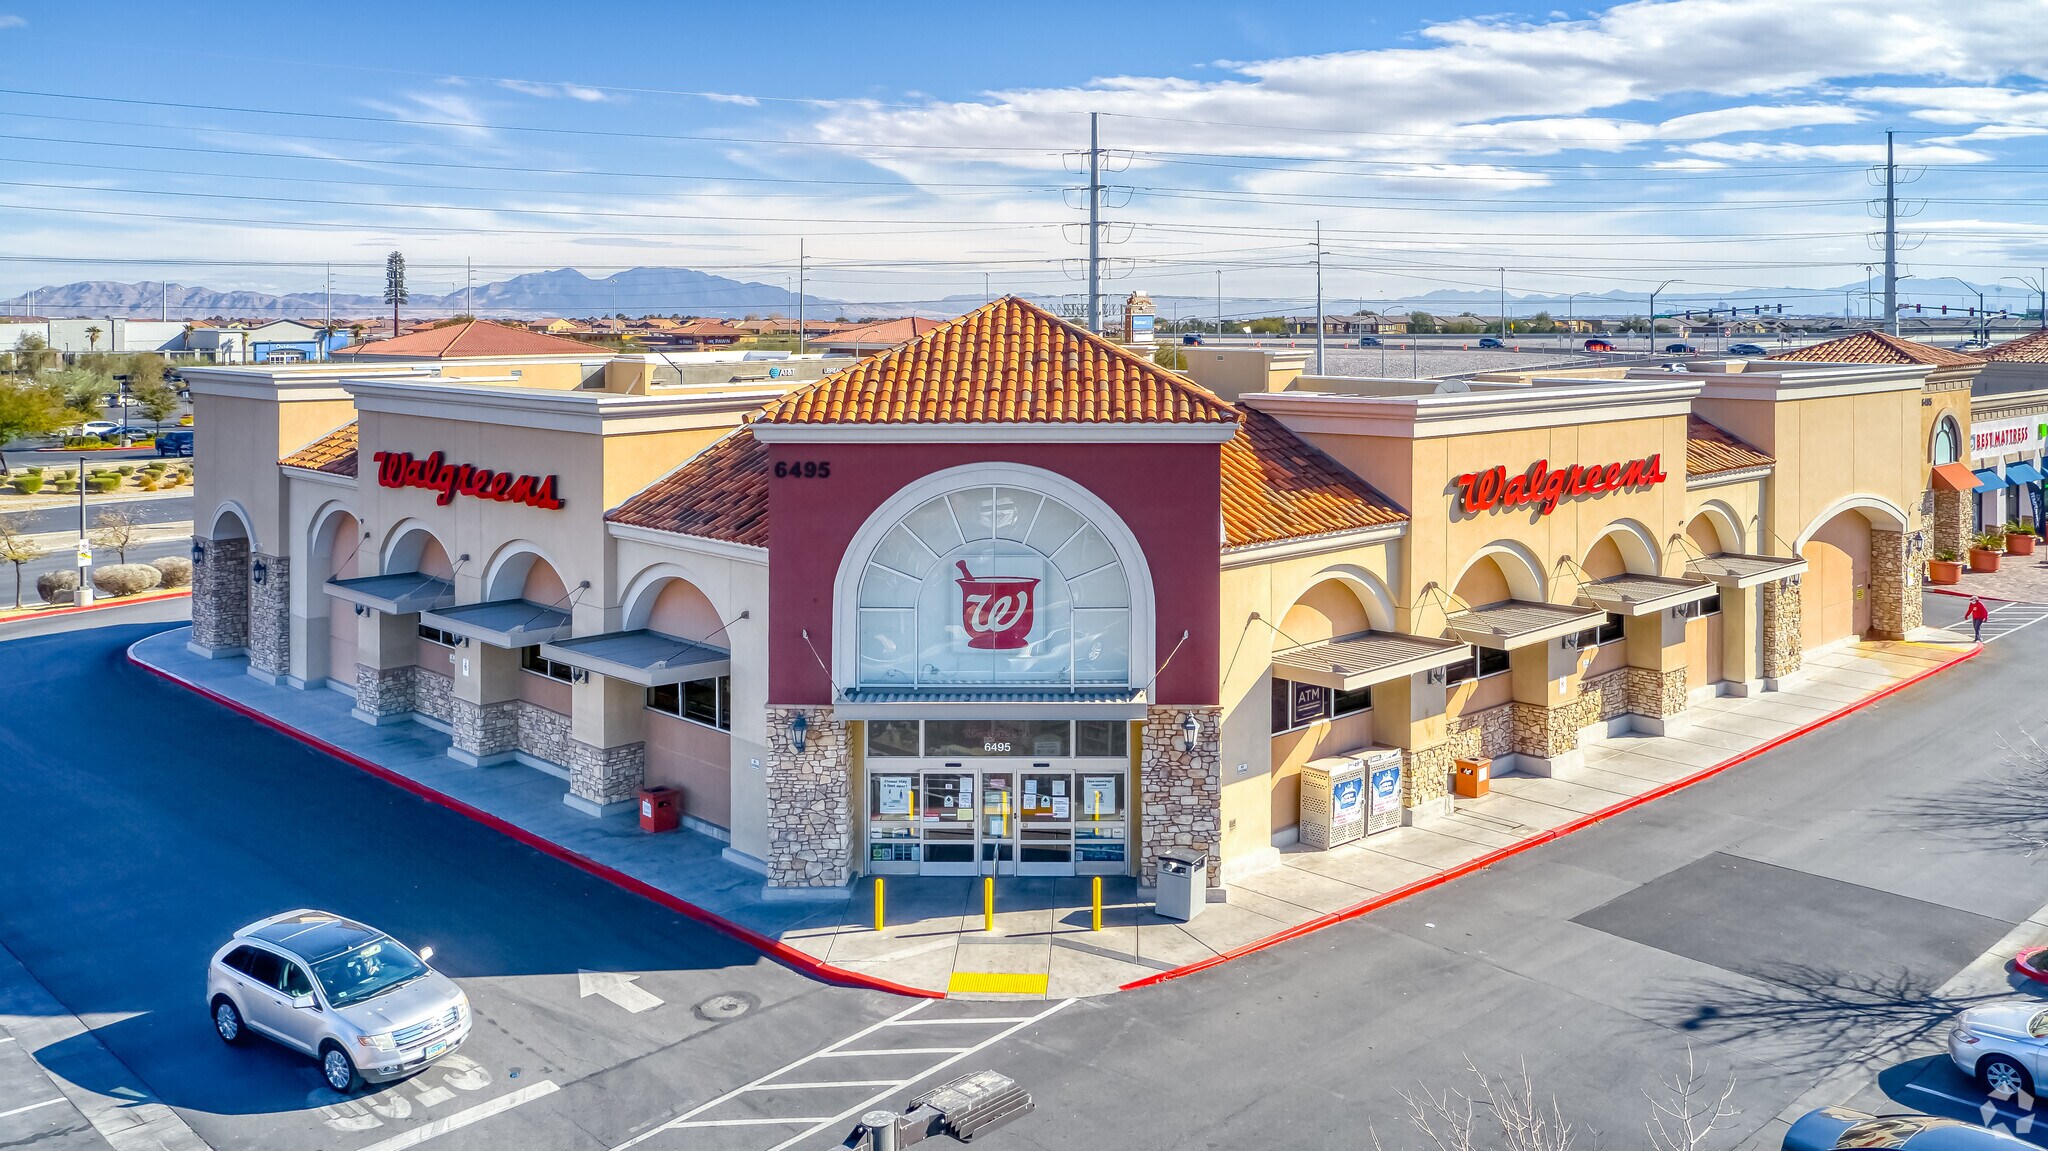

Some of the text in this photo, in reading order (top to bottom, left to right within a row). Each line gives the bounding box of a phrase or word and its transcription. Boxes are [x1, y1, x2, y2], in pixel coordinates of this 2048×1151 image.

[780, 368, 796, 376] AT&T
[1976, 427, 2029, 449] BEST MATTRESS
[774, 461, 831, 478] 6495
[373, 450, 566, 510] Walgreens
[1457, 453, 1668, 516] Walgreens
[1298, 687, 1320, 703] ATM
[984, 742, 1011, 752] 6495
